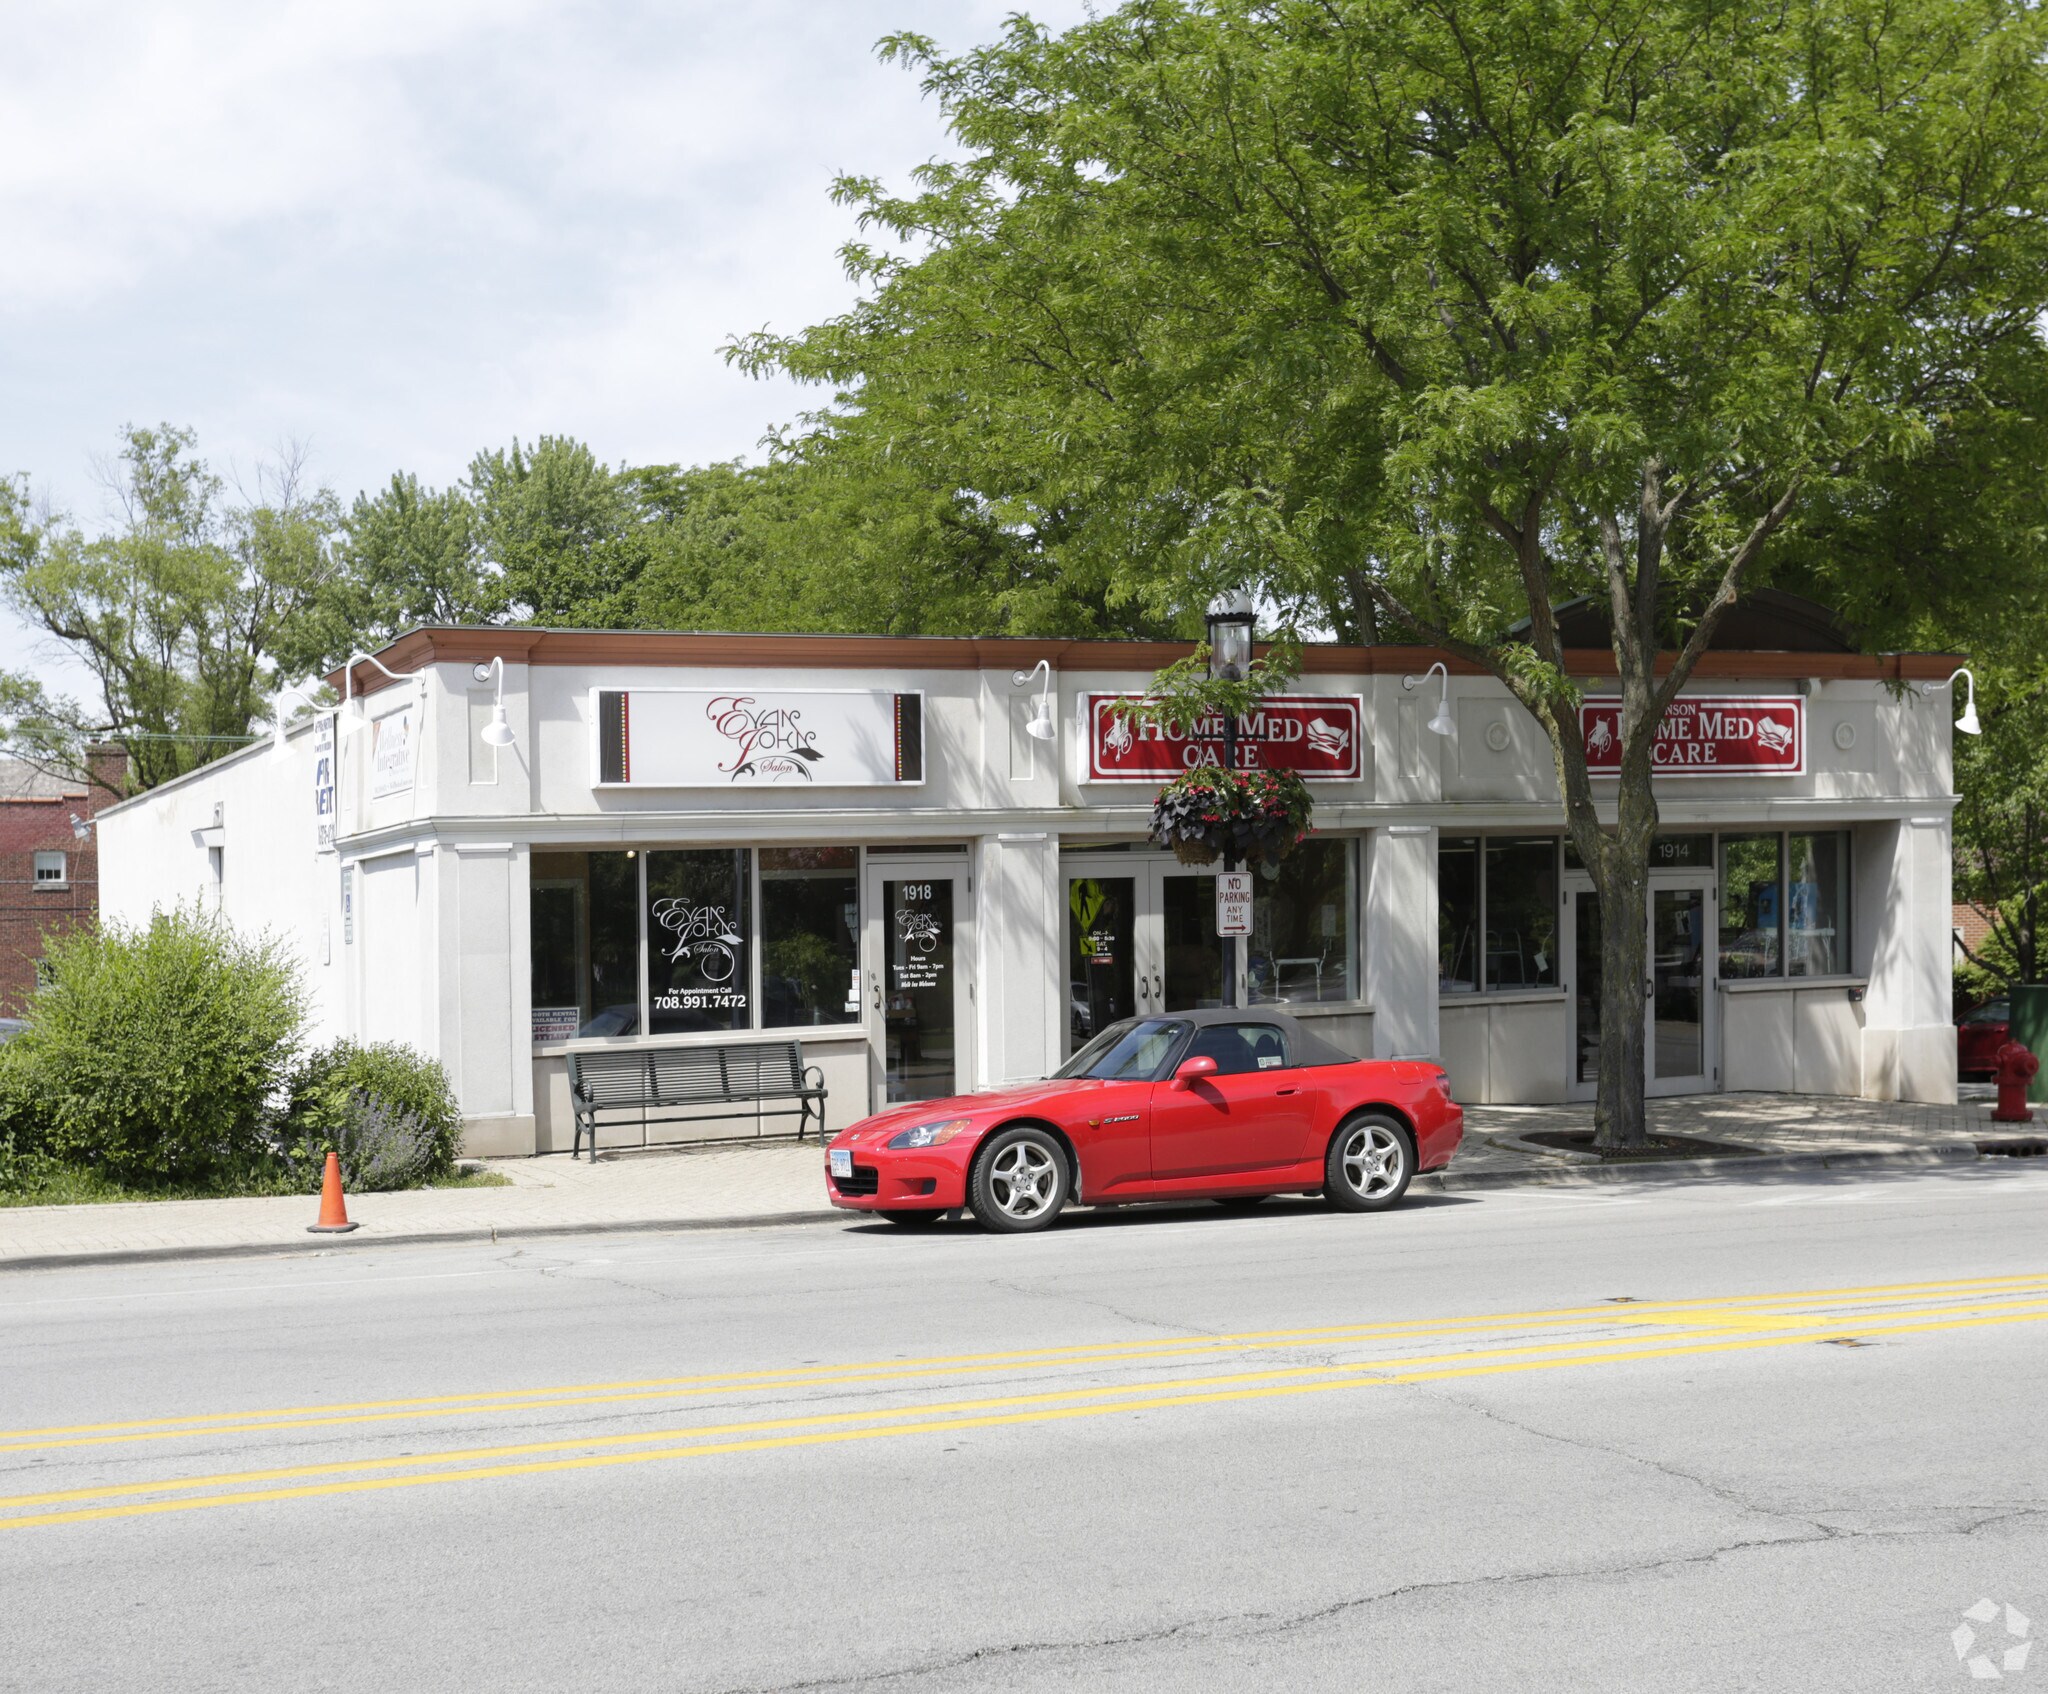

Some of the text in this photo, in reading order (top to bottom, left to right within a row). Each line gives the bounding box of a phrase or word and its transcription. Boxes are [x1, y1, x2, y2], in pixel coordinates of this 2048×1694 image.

[1698, 712, 1754, 740] MED
[1653, 742, 1717, 764] CARE
[760, 758, 794, 773] Salon
[1659, 843, 1690, 858] 1914
[1228, 878, 1241, 889] NO
[902, 884, 932, 900] 1918
[1219, 892, 1250, 903] PARKING
[1226, 906, 1243, 914] ANY
[1226, 914, 1243, 923] TIME
[668, 986, 732, 996] For Appointment Call
[654, 995, 746, 1009] 708.991.7472
